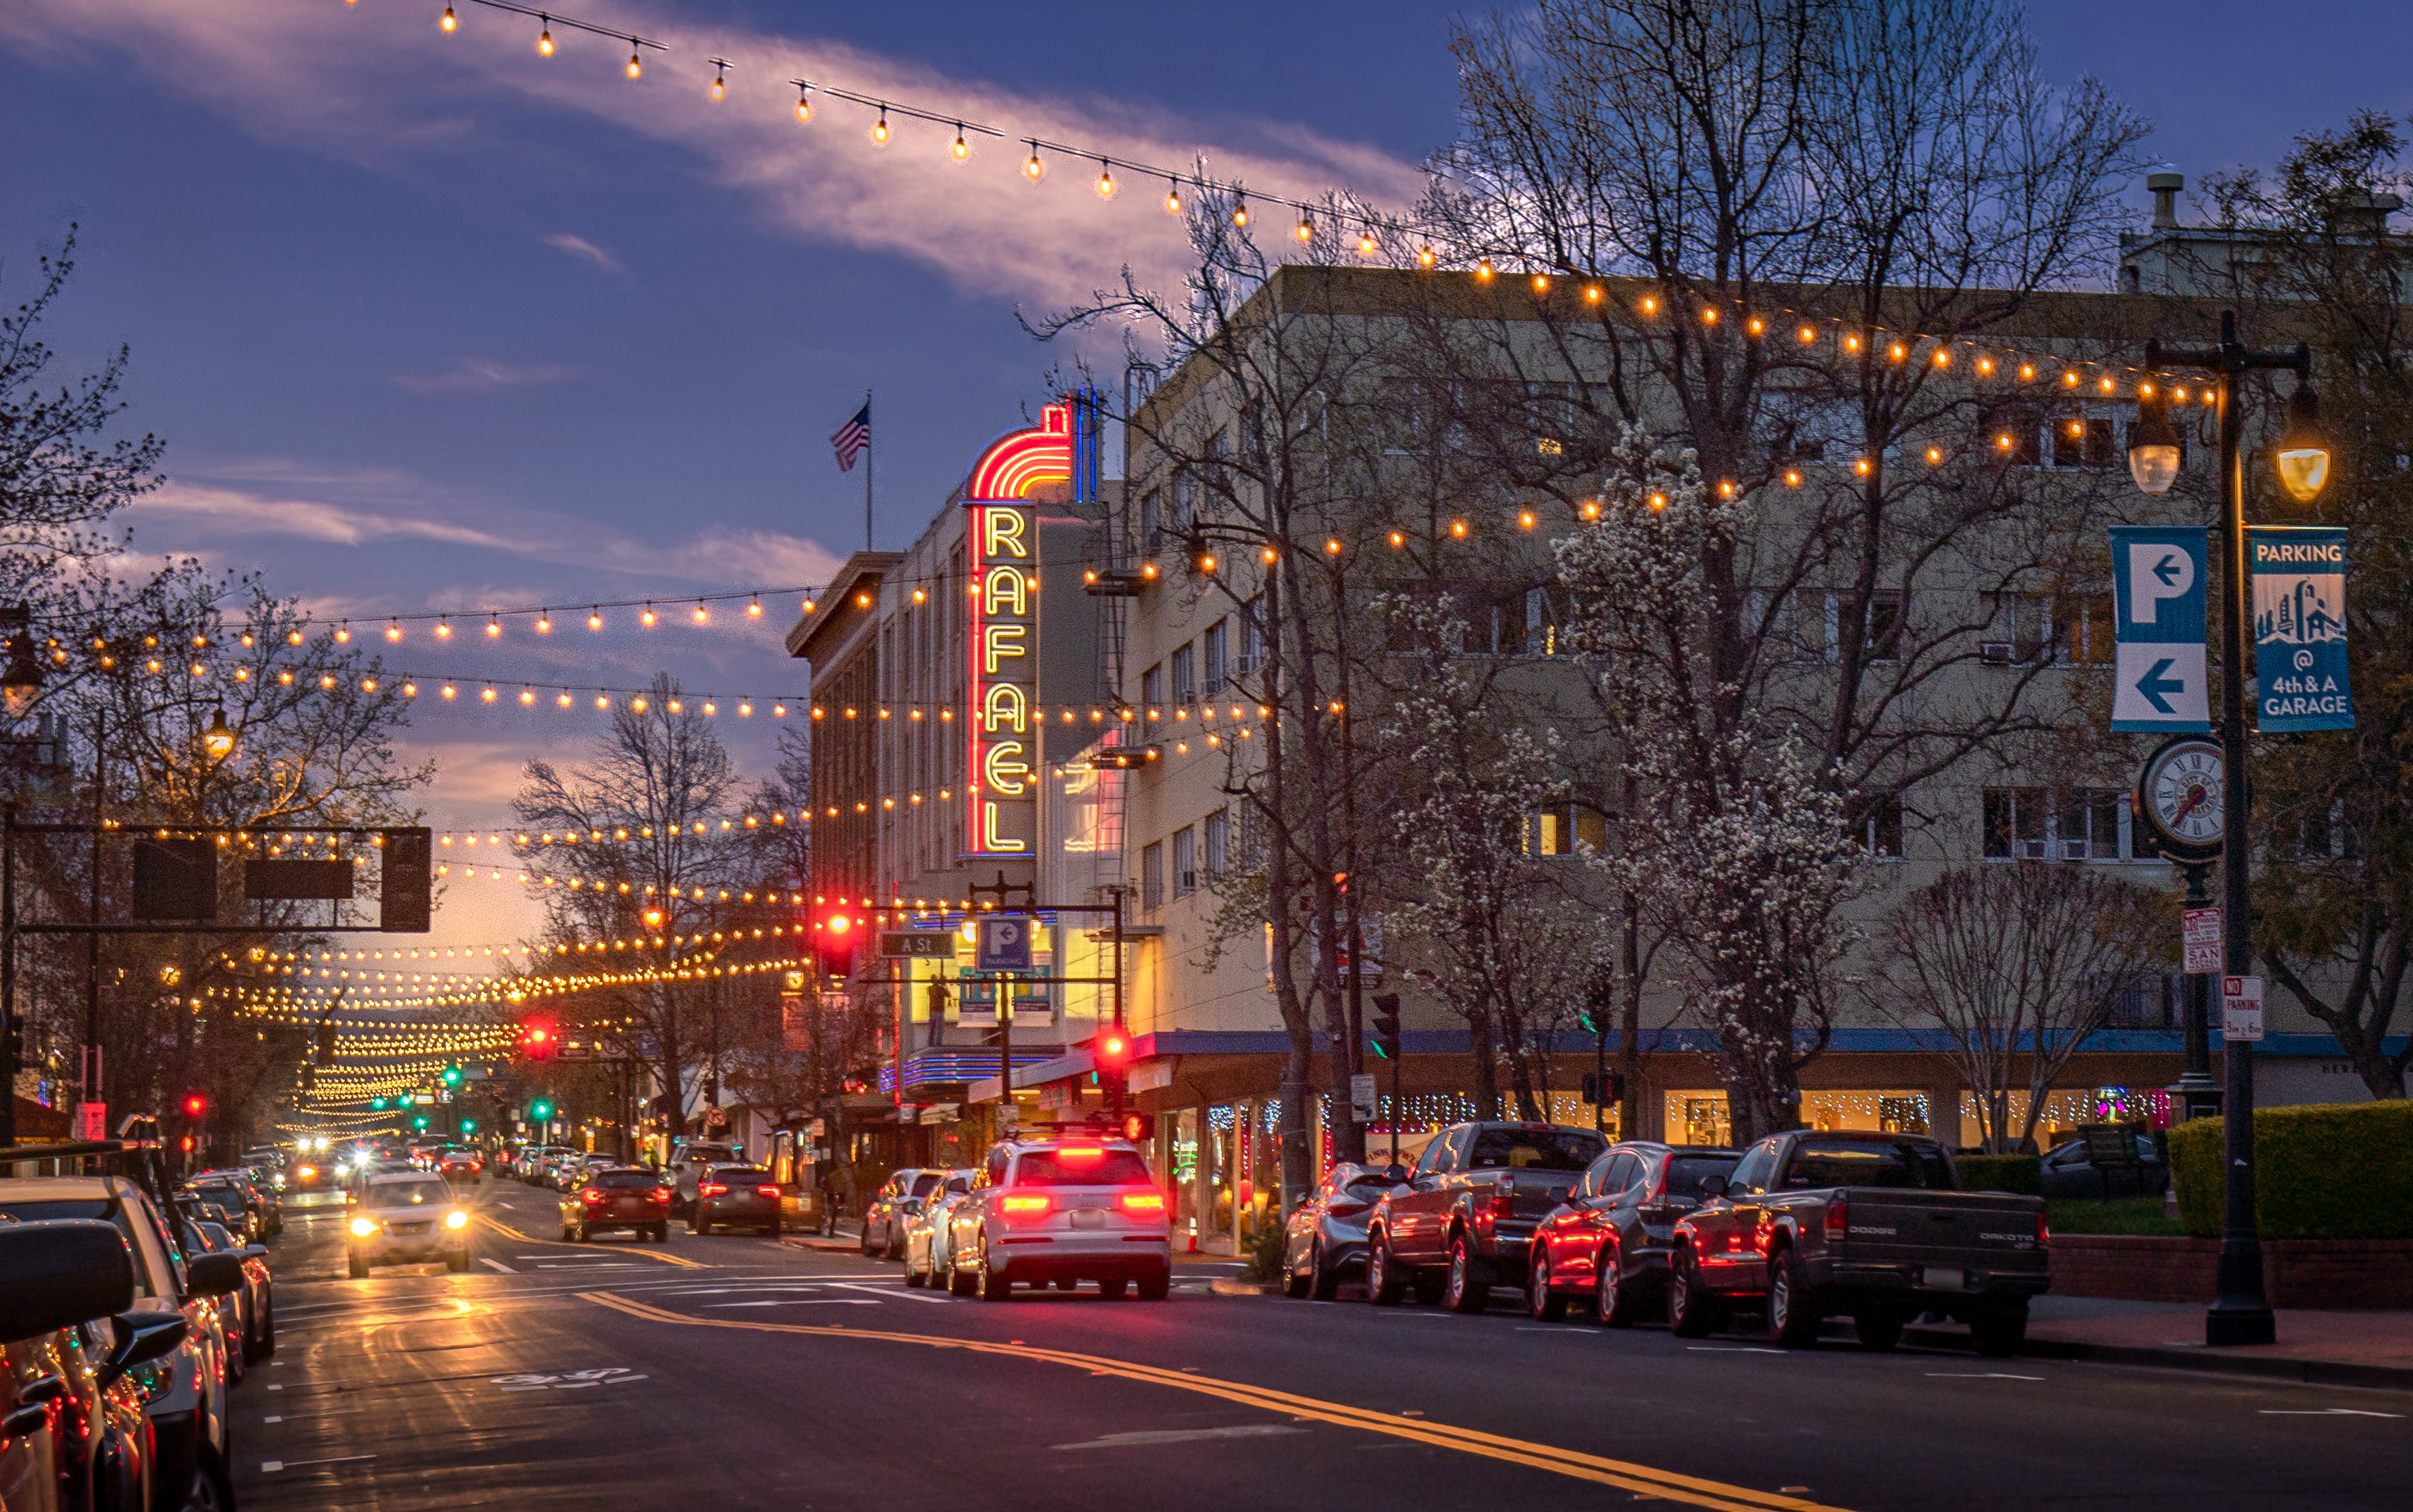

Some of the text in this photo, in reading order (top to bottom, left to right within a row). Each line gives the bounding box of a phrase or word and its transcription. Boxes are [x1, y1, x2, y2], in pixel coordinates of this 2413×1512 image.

[2257, 544, 2342, 561] PARKING
[2293, 649, 2313, 671] @
[985, 507, 1028, 851] RAFAEL
[2272, 675, 2338, 693] 4th & A
[2265, 696, 2347, 715] GARAGE
[902, 937, 931, 952] A St
[985, 957, 1022, 965] PARKING
[2189, 949, 2218, 960] SAN
[2226, 980, 2240, 994] NO
[2227, 999, 2260, 1011] PARKING
[1367, 1148, 1389, 1161] INK
[1849, 1226, 1897, 1235] DODGE
[1979, 1232, 2035, 1242] DAKOTA
